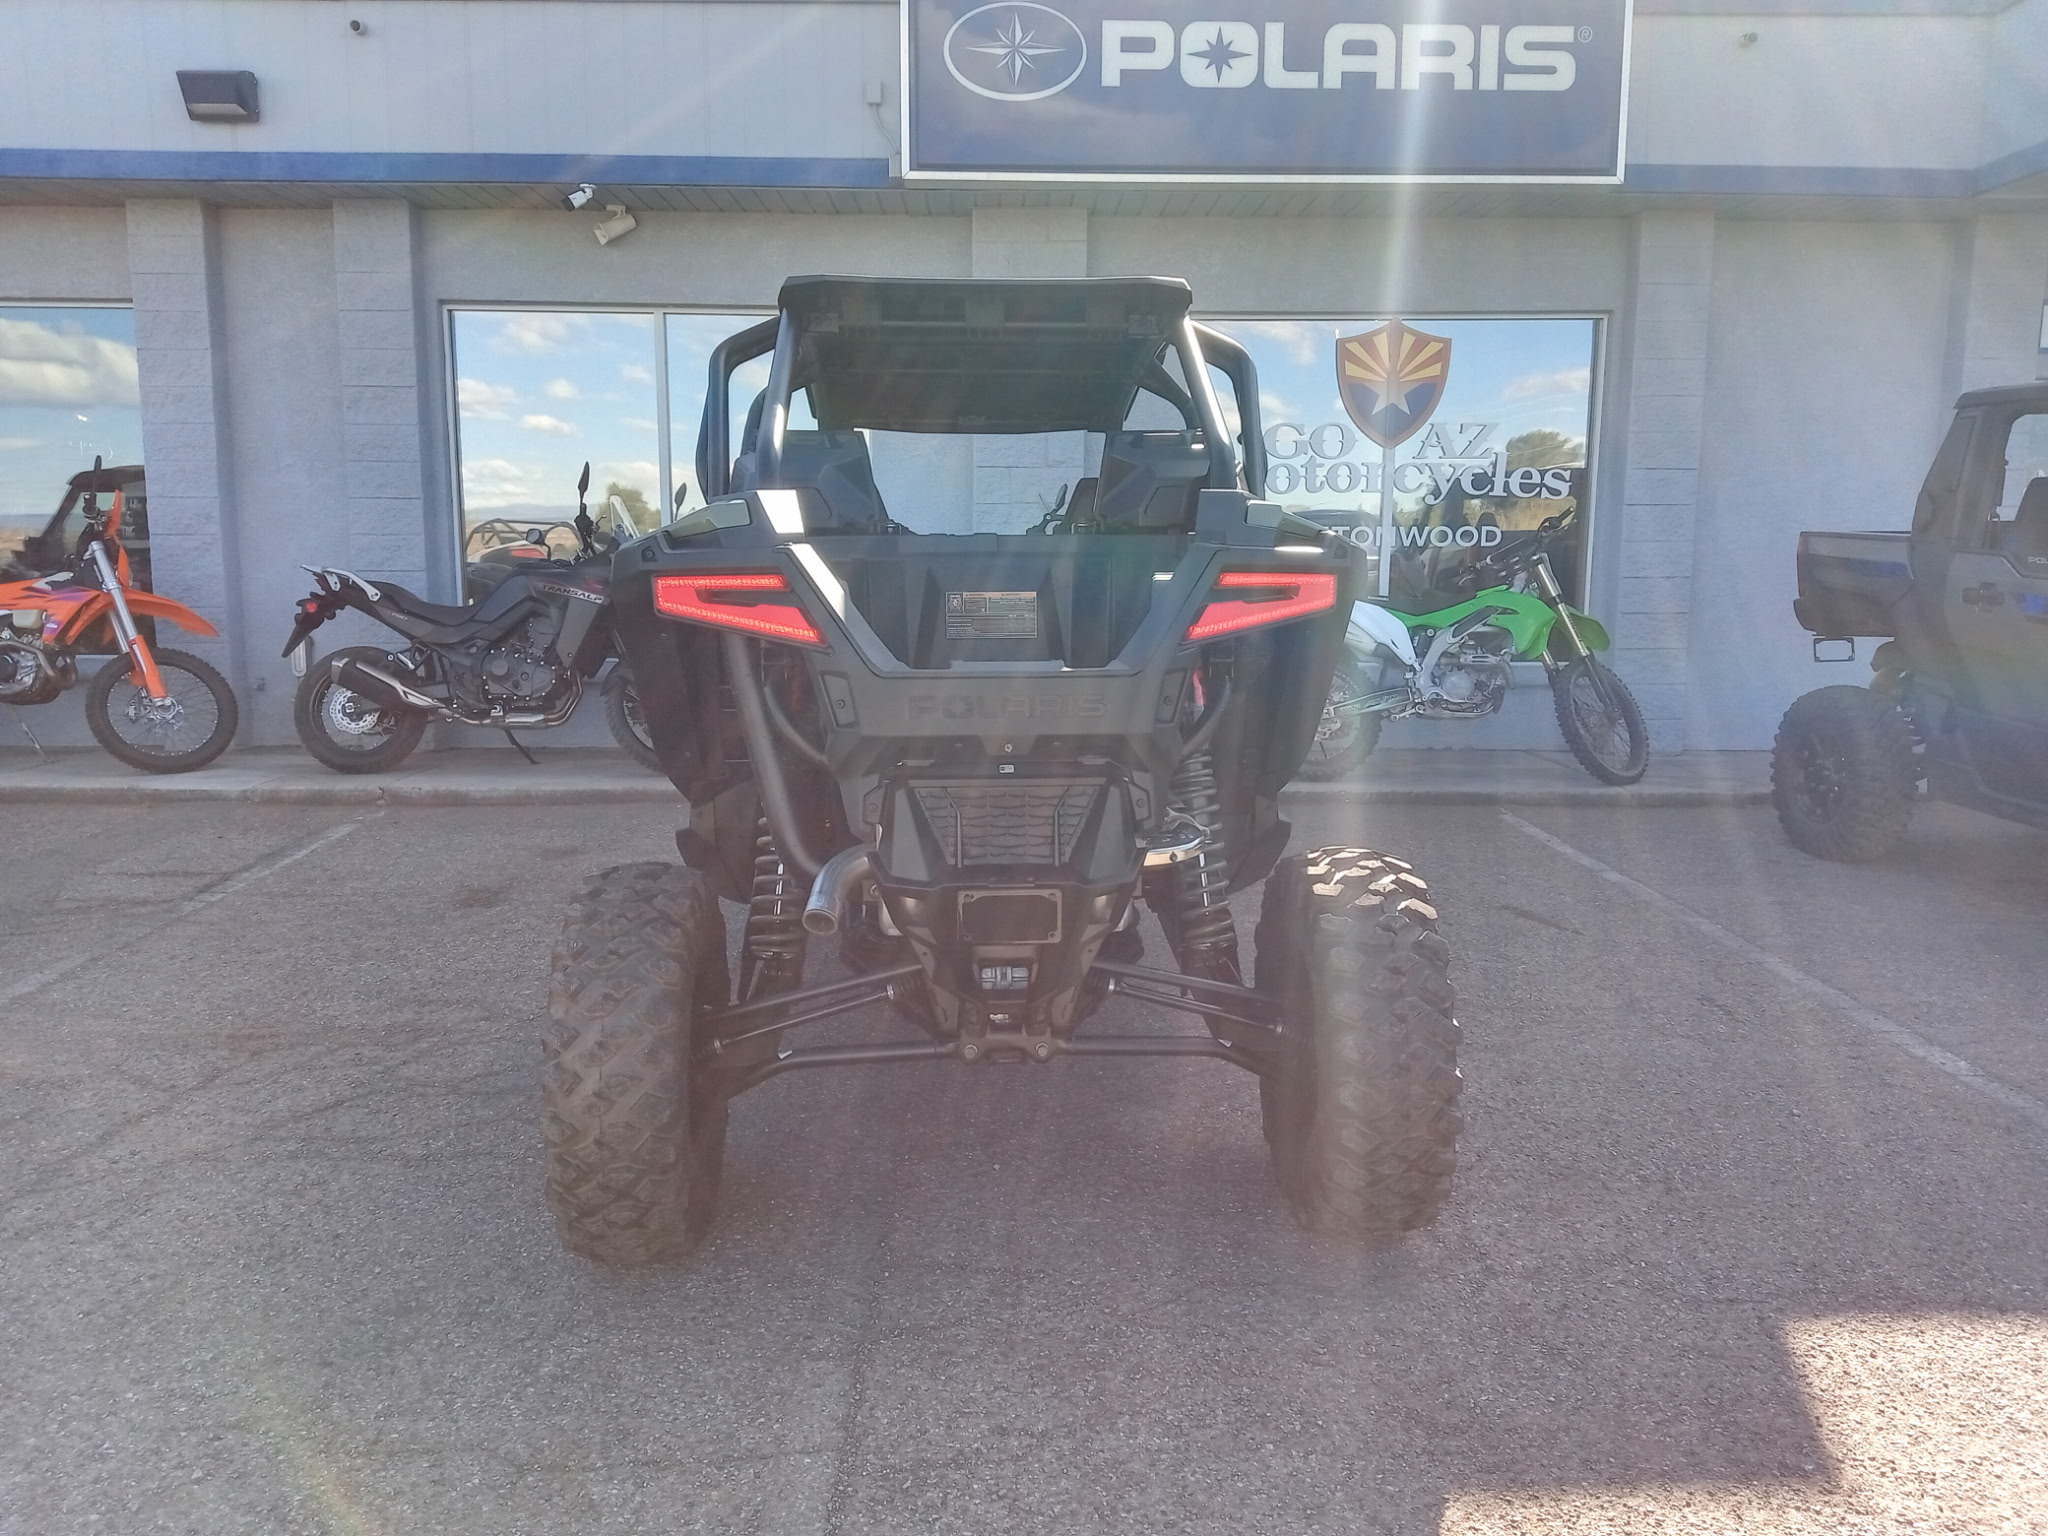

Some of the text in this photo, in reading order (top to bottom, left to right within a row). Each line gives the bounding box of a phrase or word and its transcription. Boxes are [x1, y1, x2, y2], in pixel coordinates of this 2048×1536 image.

[1101, 20, 1577, 92] POLARIS
[1263, 422, 1500, 460] GO AZ
[1265, 451, 1573, 505] otorcycles
[1325, 525, 1502, 548] TONWOOD
[542, 583, 604, 602] TRANSALP
[909, 693, 1107, 719] POLARIS
